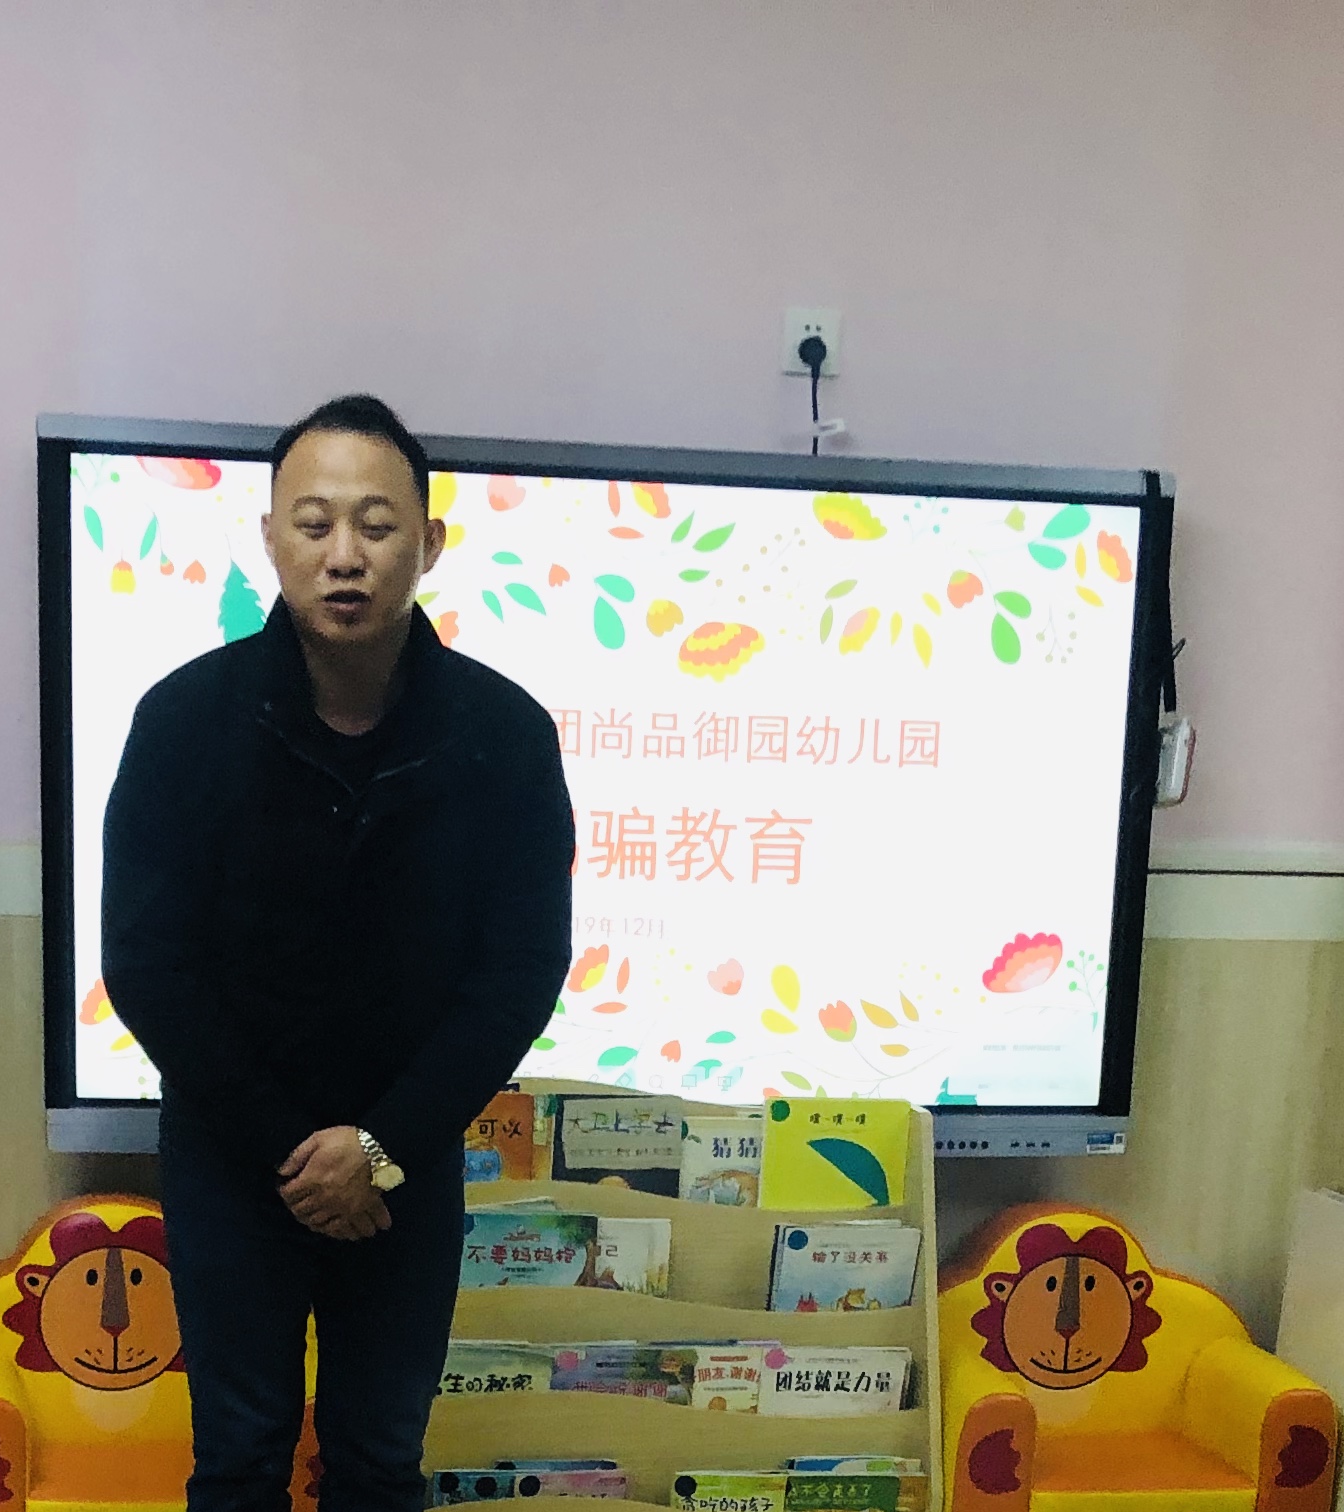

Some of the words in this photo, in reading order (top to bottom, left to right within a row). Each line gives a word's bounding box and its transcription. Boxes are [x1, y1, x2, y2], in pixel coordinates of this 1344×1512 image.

[570, 805, 813, 885] 骗教育
[435, 1372, 534, 1394] 生的秘密
[775, 1369, 892, 1394] 团结就是力量
